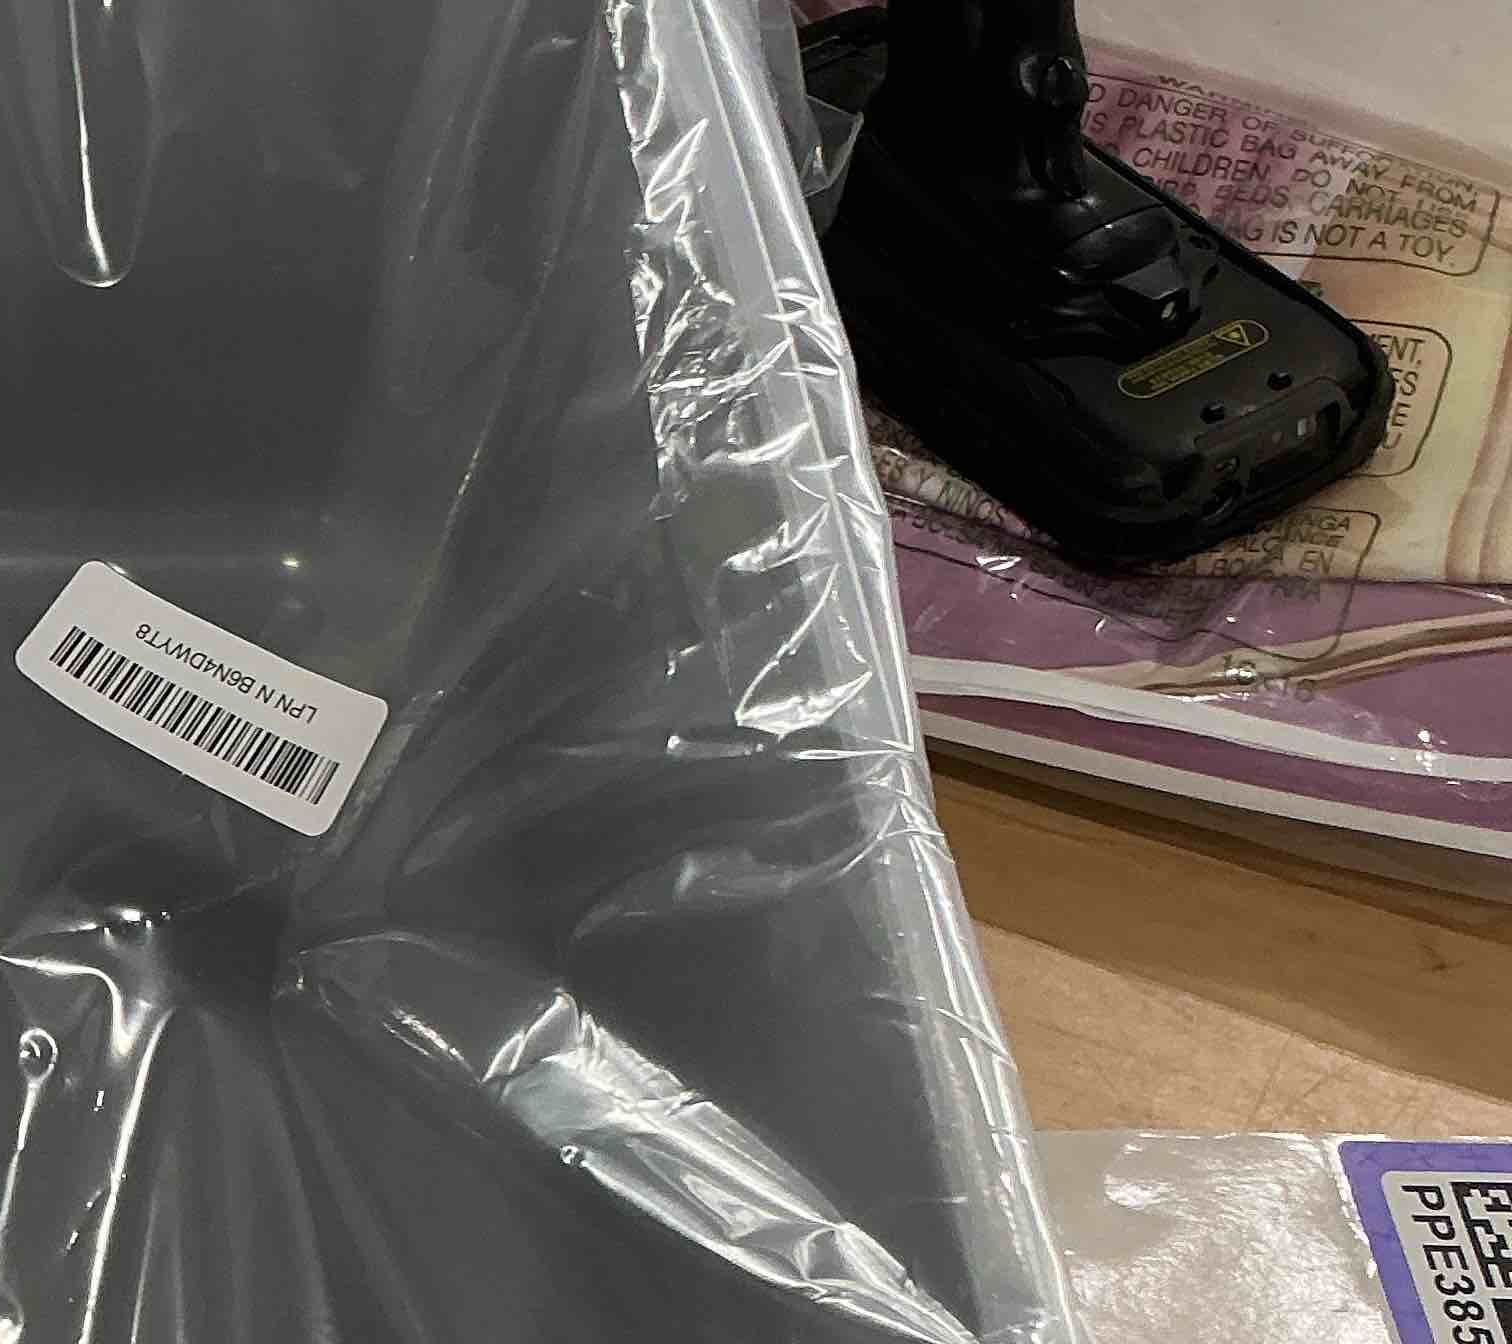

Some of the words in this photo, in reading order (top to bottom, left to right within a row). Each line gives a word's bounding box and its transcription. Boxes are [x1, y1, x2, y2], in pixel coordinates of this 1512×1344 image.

[1118, 88, 1228, 123] DANGER
[1242, 115, 1280, 133] OF
[1118, 116, 1230, 149] PLASTIC
[1240, 135, 1298, 160] BAG
[1309, 151, 1390, 180] AWAY
[1400, 174, 1477, 213] FROM
[1290, 168, 1331, 188] DO
[1345, 179, 1400, 205] NOT
[1270, 220, 1299, 244] IS
[1303, 223, 1366, 249] NOT
[1368, 231, 1387, 251] A
[1399, 232, 1456, 268] TOY.
[135, 623, 257, 695] B6N4DWYT8
[275, 693, 318, 724] LPN
